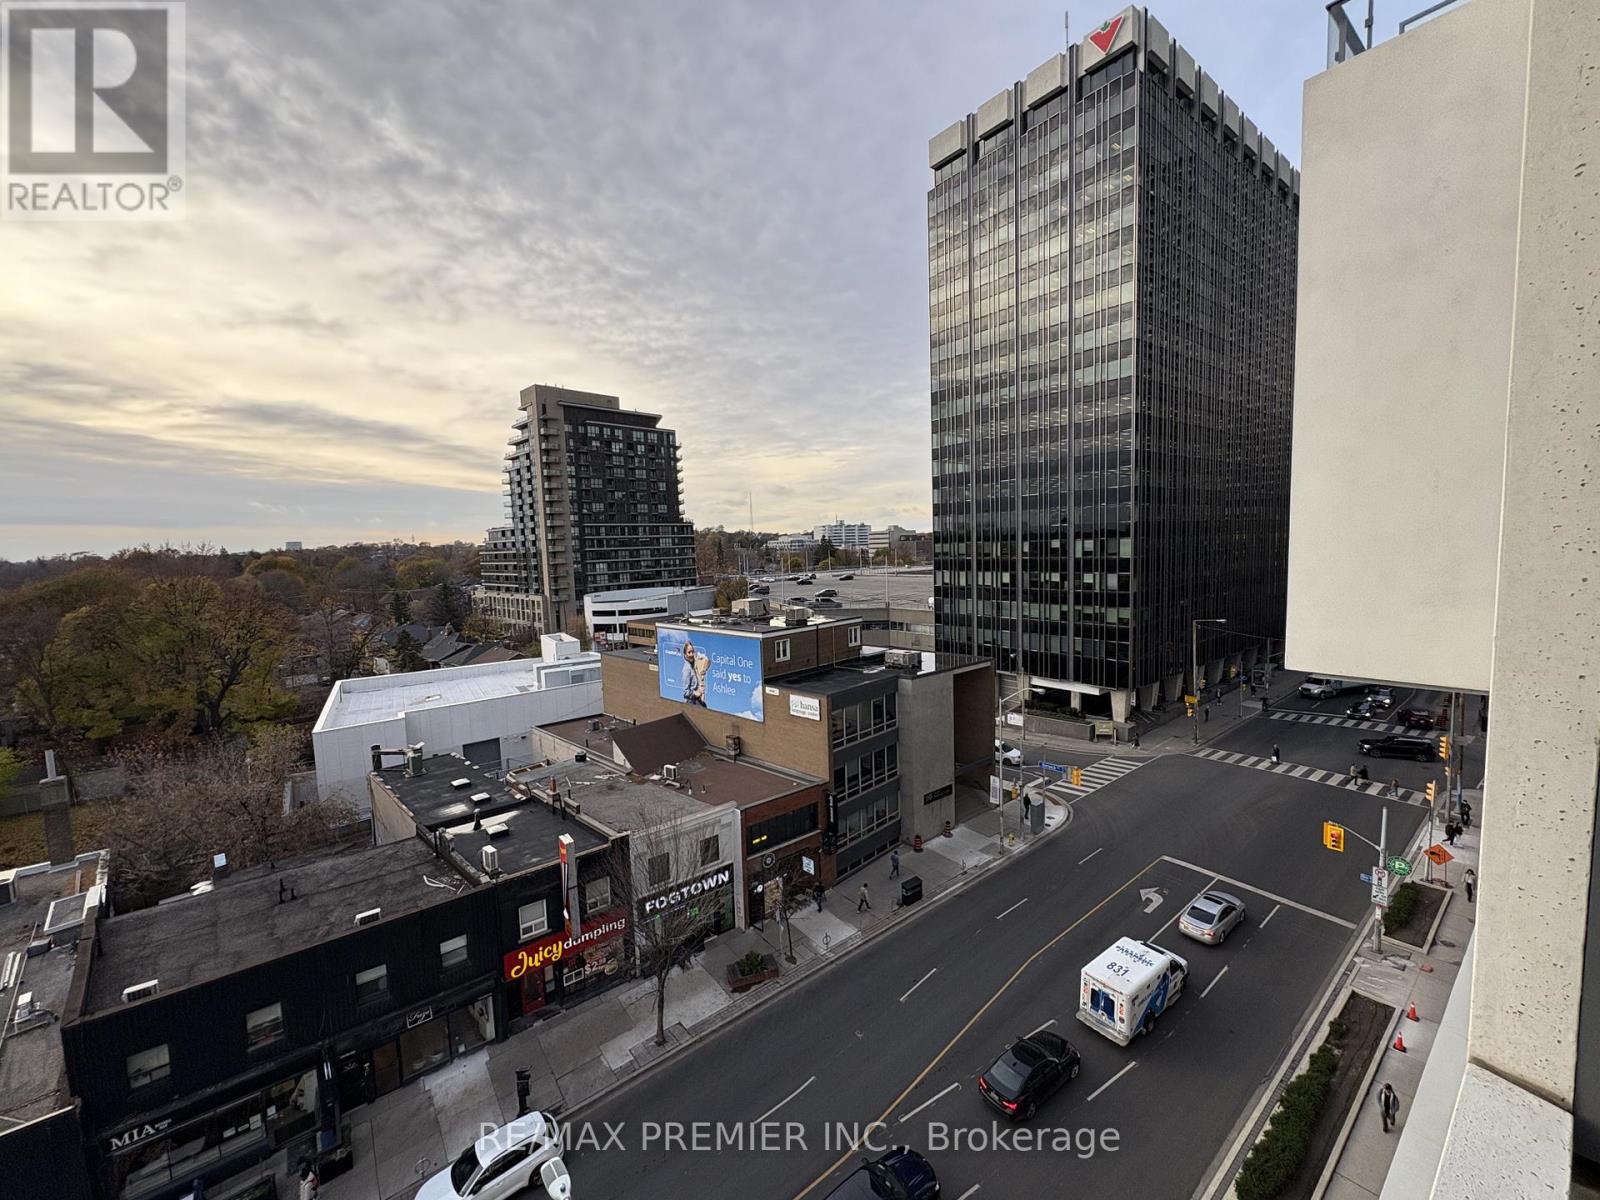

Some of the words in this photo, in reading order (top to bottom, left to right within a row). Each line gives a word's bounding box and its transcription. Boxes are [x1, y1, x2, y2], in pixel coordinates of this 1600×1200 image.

[711, 652, 736, 667] Capital
[737, 656, 753, 669] One
[711, 669, 727, 680] said
[728, 671, 742, 683] yes
[743, 673, 752, 685] to
[712, 682, 736, 696] Ashlee
[645, 870, 730, 914] FOGTOWN
[511, 940, 563, 978] Juicy
[563, 918, 626, 949] dumpling
[1106, 961, 1130, 977] 831
[109, 1124, 157, 1151] MIA
